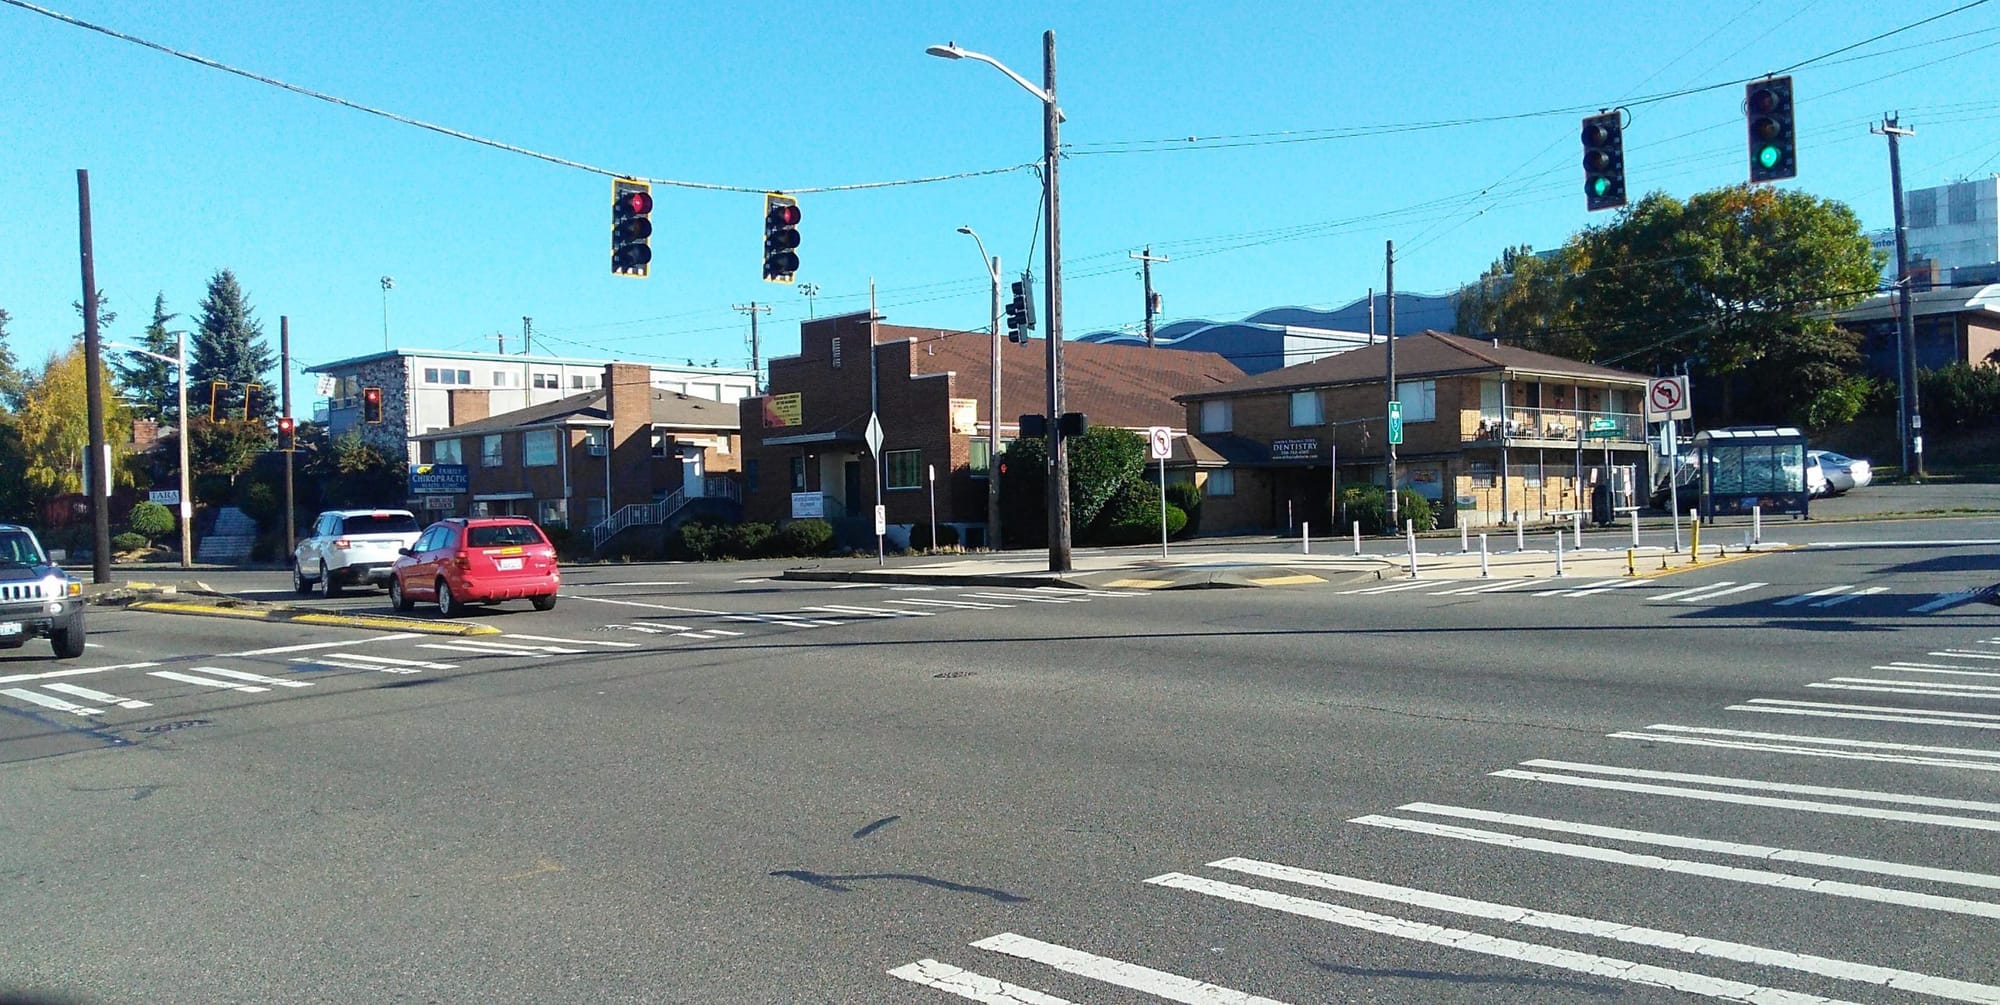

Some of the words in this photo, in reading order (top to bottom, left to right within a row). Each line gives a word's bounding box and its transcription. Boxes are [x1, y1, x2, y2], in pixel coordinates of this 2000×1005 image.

[1273, 442, 1318, 451] DENTISTRY
[412, 474, 468, 483] CHIROPRACTIC
[151, 491, 178, 499] TARA
